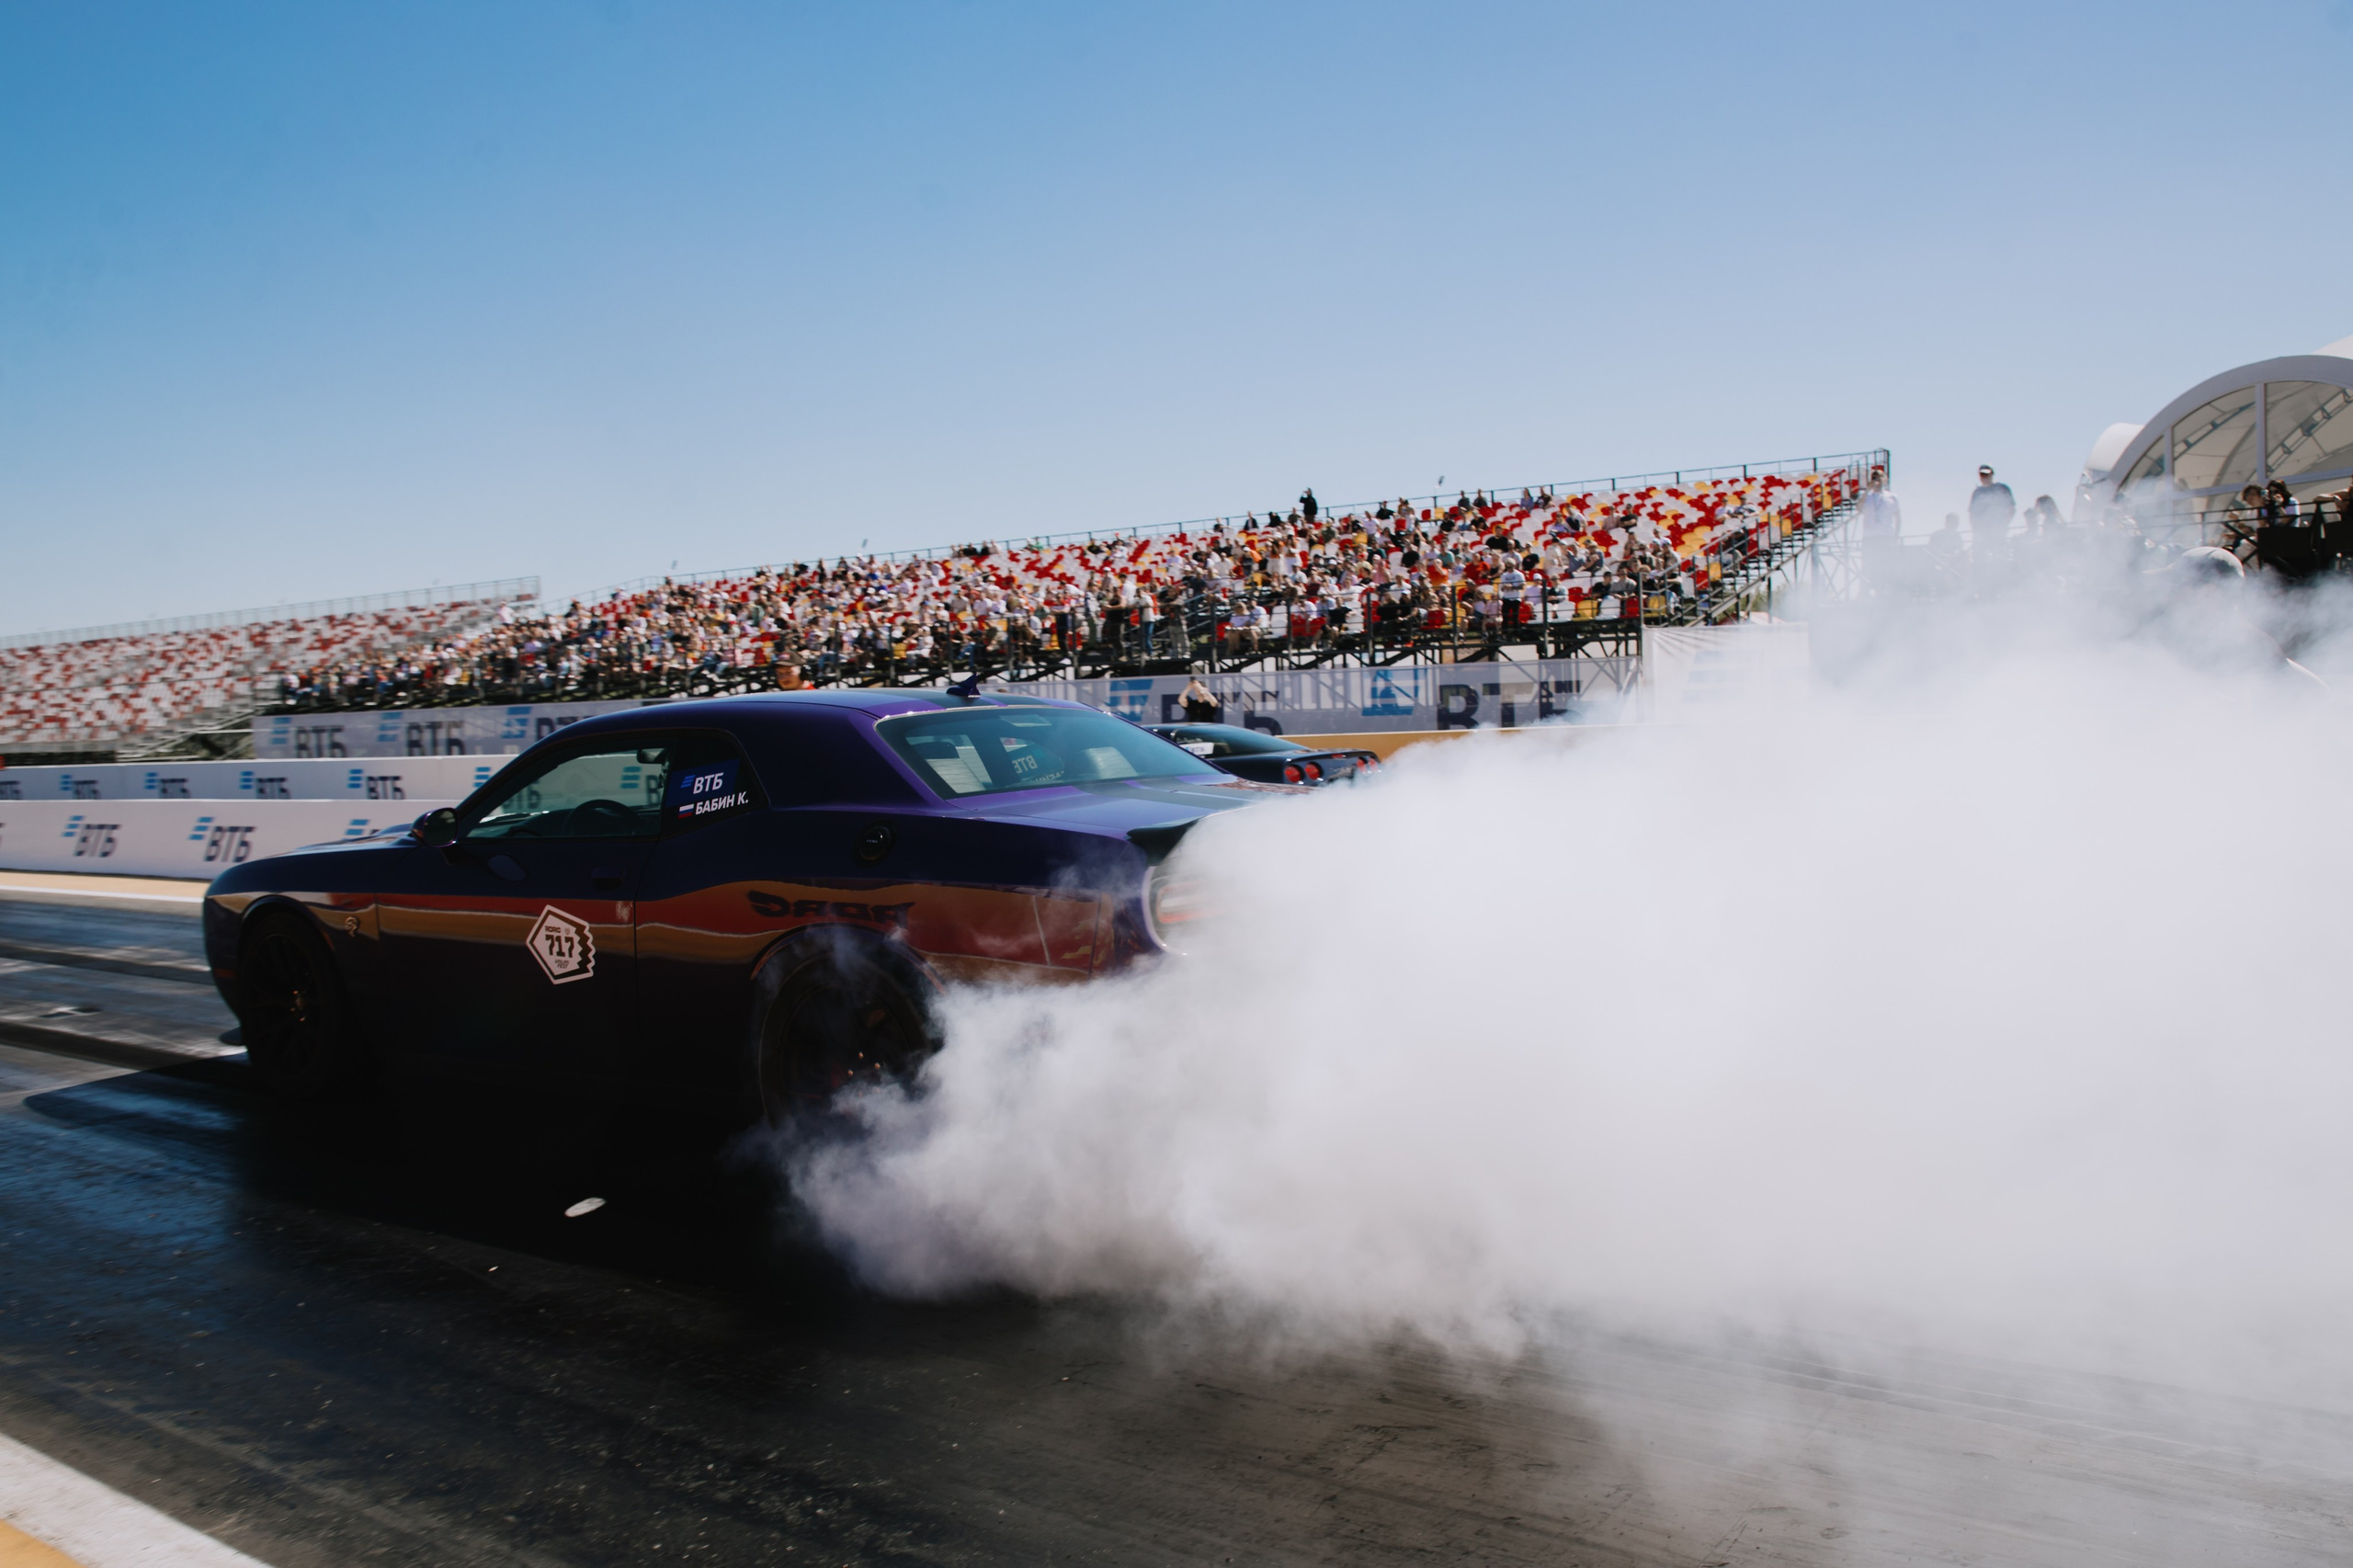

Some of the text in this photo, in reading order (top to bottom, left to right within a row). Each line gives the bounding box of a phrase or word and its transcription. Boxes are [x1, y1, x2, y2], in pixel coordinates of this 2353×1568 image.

[366, 776, 405, 799] ВТБ
[693, 772, 724, 794] ВТБ
[695, 791, 749, 815] БАБИН К.
[74, 824, 122, 857] ВТБ
[204, 826, 256, 863] ВТБ
[545, 934, 574, 958] 717
